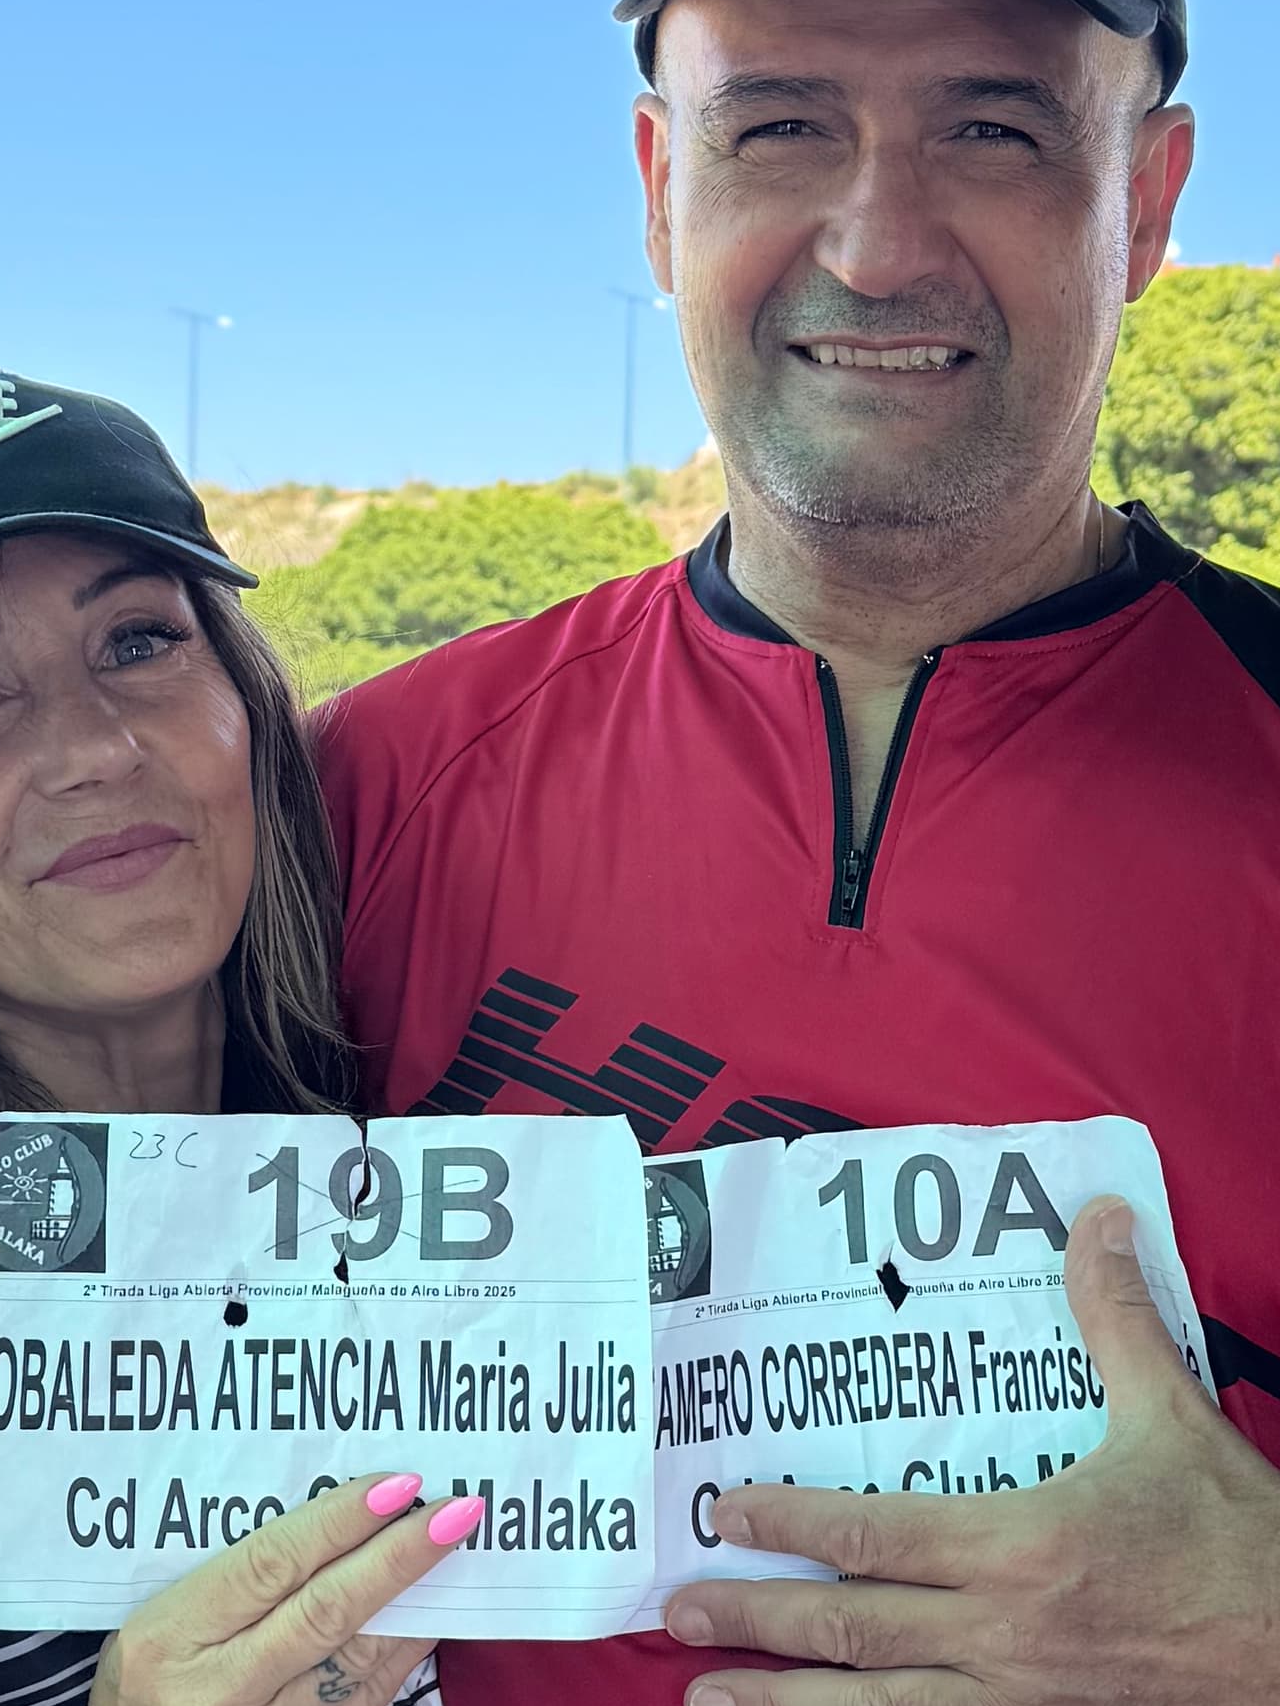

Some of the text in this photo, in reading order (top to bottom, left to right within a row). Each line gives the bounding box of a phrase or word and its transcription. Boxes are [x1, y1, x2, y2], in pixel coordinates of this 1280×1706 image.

[14, 1134, 54, 1161] CLUB
[248, 1145, 515, 1262] 19B
[818, 1150, 1069, 1265] 10A
[101, 1284, 144, 1297] Tirada
[149, 1284, 179, 1299] Liga
[184, 1284, 234, 1297] Abierta
[238, 1283, 308, 1297] Provincial
[312, 1284, 386, 1299] Malagueña
[390, 1285, 408, 1297] de
[411, 1285, 440, 1297] Aire
[444, 1285, 480, 1297] Libre
[484, 1285, 517, 1298] 2025
[708, 1298, 739, 1317] Tirada
[742, 1297, 769, 1311] Liga
[821, 1283, 883, 1301] Provincial
[958, 1279, 975, 1292] de
[1008, 1275, 1043, 1289] Libre
[211, 1336, 405, 1432] ATENCIA
[418, 1338, 531, 1434] Maria
[545, 1339, 638, 1435] Julia
[654, 1349, 754, 1451] AMERO
[760, 1330, 965, 1433] CORREDERA
[967, 1326, 1106, 1415] Francisc
[65, 1477, 137, 1551] Cd
